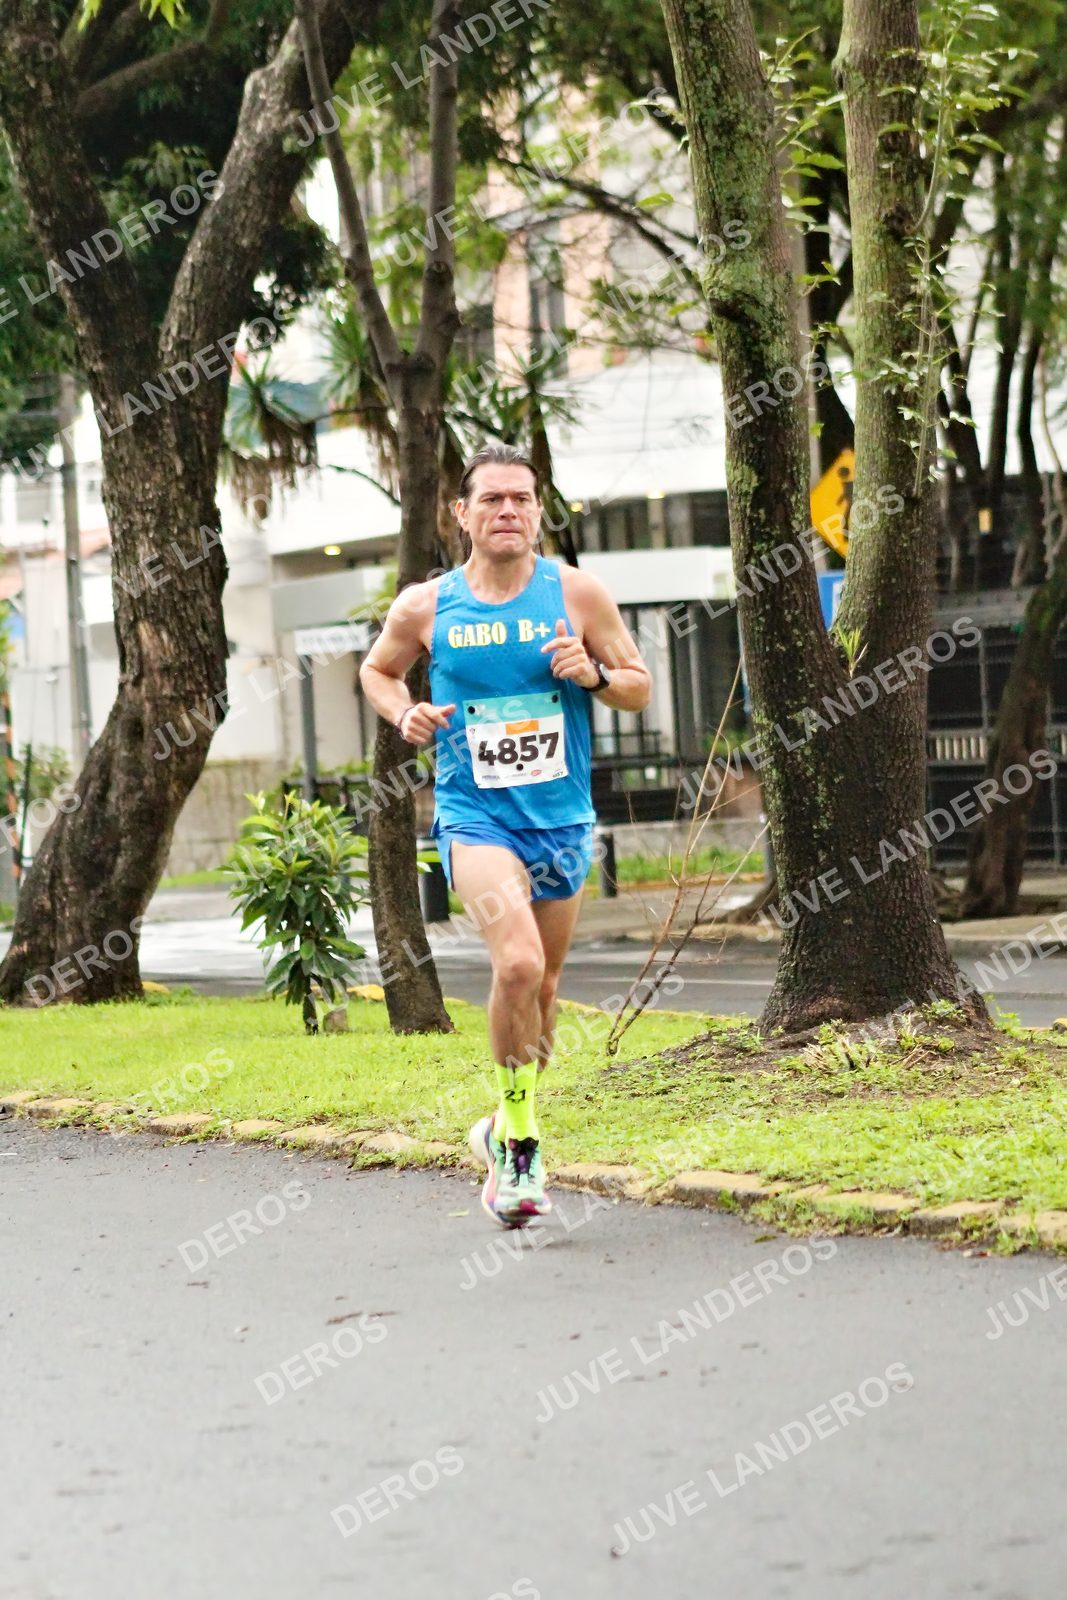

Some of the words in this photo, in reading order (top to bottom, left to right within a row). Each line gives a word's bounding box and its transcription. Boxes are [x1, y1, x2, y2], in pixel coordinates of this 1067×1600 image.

[448, 621, 507, 648] GABO
[517, 619, 551, 643] B+
[478, 732, 559, 766] 4857
[504, 1089, 526, 1102] 21
